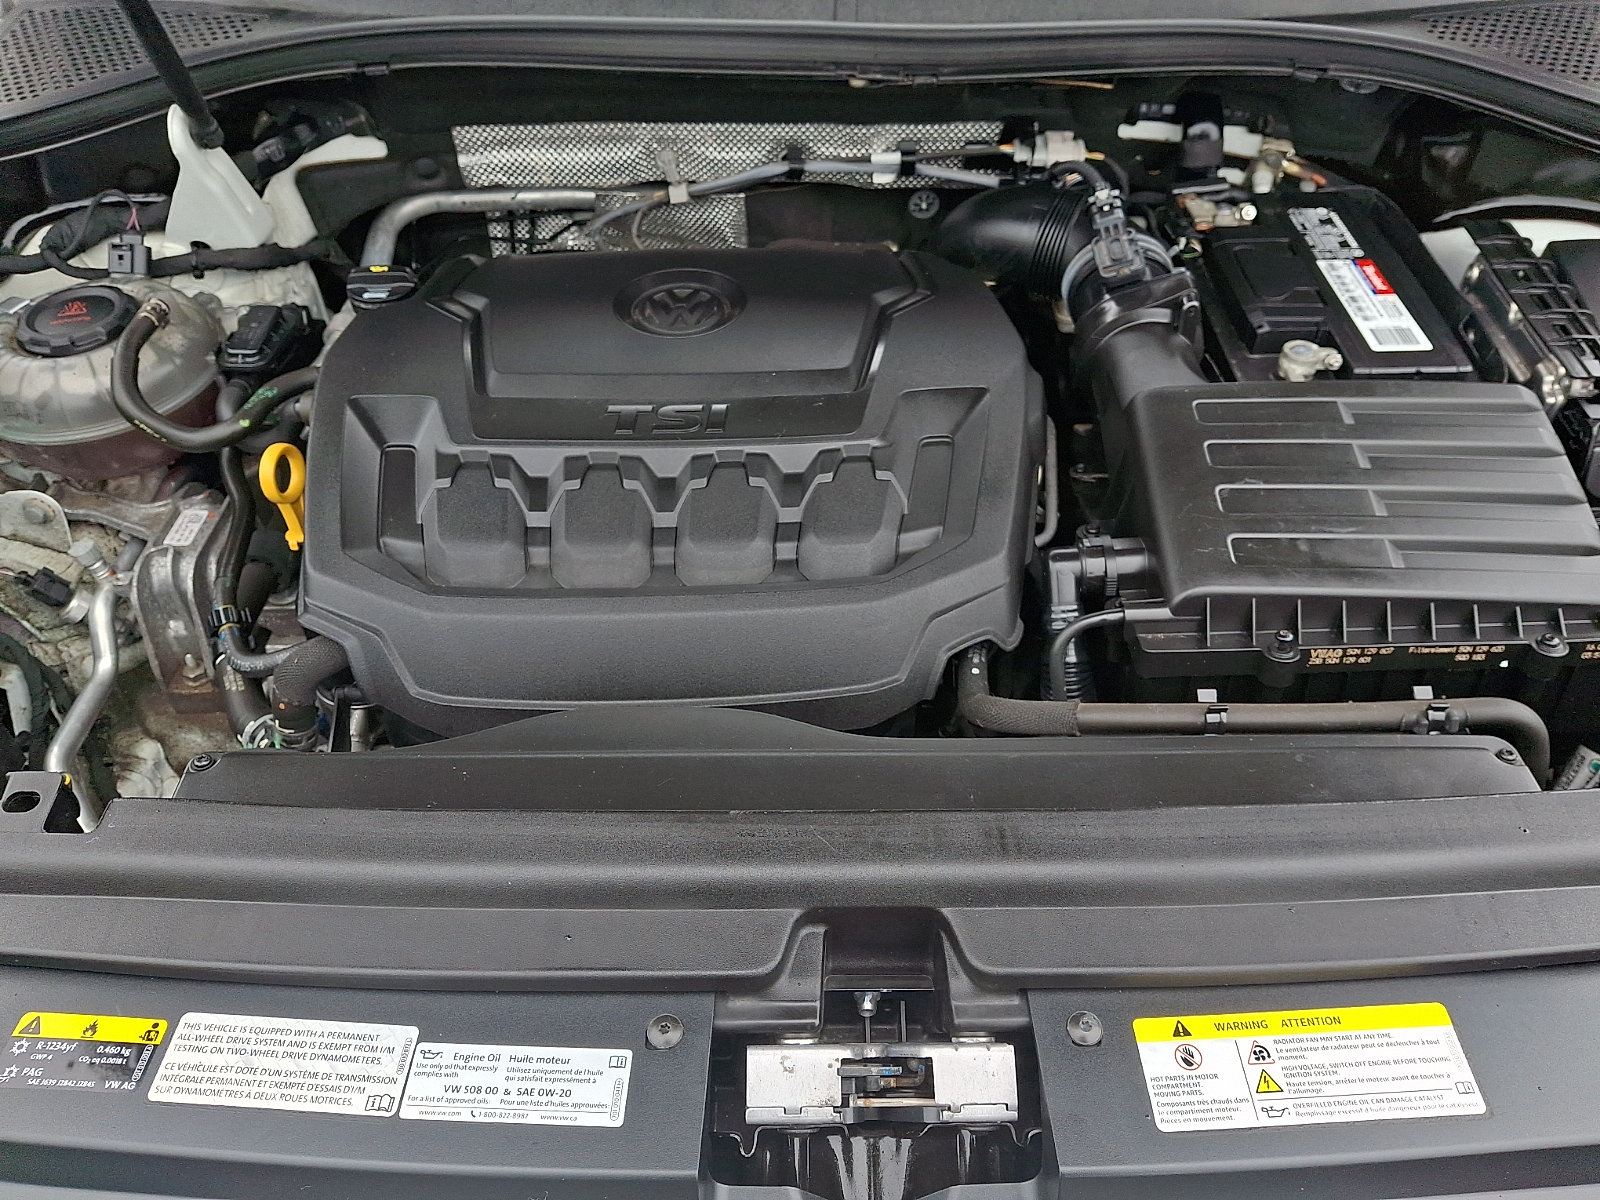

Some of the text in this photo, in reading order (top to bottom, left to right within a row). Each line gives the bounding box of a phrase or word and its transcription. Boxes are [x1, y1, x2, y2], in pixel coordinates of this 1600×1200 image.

[605, 404, 730, 434] TSI
[1214, 1016, 1342, 1032] WARNING ATTENTION
[182, 1022, 381, 1042] THIS VEHICLE IS EQUIPPED WITH A PERMANENT
[35, 1041, 132, 1058] R-1234yf 0.460 kg
[176, 1033, 395, 1055] ALL-WHEEL DRIVE SYSTEM AND IS EXEMPT FROM I/M
[173, 1043, 383, 1065] TESTING ON TWO-WHEEL DRIVE DYNAMOMETERS.
[453, 1052, 501, 1064] Engine Oil
[508, 1054, 571, 1065] Huile moteur
[91, 1057, 100, 1065] eq
[1368, 1059, 1392, 1067] ENGINE
[21, 1067, 44, 1077] PAG
[164, 1062, 176, 1071] CE
[177, 1061, 218, 1073] VÉHICULE
[219, 1065, 234, 1073] EST
[234, 1065, 259, 1076] DOTÉ
[259, 1067, 283, 1077] D'UN
[321, 1072, 333, 1081] DE
[334, 1073, 398, 1085] TRANSMISSION
[429, 1063, 444, 1071] only
[453, 1063, 468, 1071] that
[468, 1064, 499, 1074] expressly
[506, 1066, 531, 1074] Utilisez
[532, 1068, 573, 1076] uniquement
[573, 1068, 583, 1076] de
[413, 1070, 443, 1079] complies
[504, 1075, 516, 1083] qui
[516, 1075, 543, 1083] satisfait
[544, 1076, 591, 1085] expressément
[1194, 1073, 1220, 1081] MOTOR
[104, 1080, 121, 1089] VW
[121, 1081, 136, 1090] AG
[205, 1076, 258, 1087] PERMANENT
[257, 1079, 268, 1088] ET
[306, 1083, 342, 1093] D'ESSAIS
[1152, 1081, 1204, 1090] COMPARTMENT.
[154, 1085, 173, 1094] SUR
[253, 1091, 278, 1101] DEUX
[279, 1093, 308, 1103] ROUES
[309, 1095, 353, 1106] MOTRICES.
[444, 1084, 572, 1098] VW 508 00 & SAE 0W-20
[1153, 1090, 1181, 1098] MOVING
[407, 1094, 419, 1102] For
[425, 1095, 435, 1103] list
[436, 1095, 444, 1103] of
[444, 1096, 476, 1105] approved
[499, 1098, 516, 1106] Pour
[529, 1099, 544, 1107] liste
[544, 1100, 570, 1108] d'huiles
[1156, 1099, 1196, 1108] Composants
[1210, 1097, 1233, 1105] chauds
[1233, 1096, 1250, 1104] dans
[1333, 1099, 1358, 1107] ENGINE
[1386, 1096, 1413, 1104] DAMAGE
[418, 1109, 462, 1117] www.vw.com
[1165, 1107, 1214, 1116] compartiment
[540, 1114, 578, 1122] www.vw.ca
